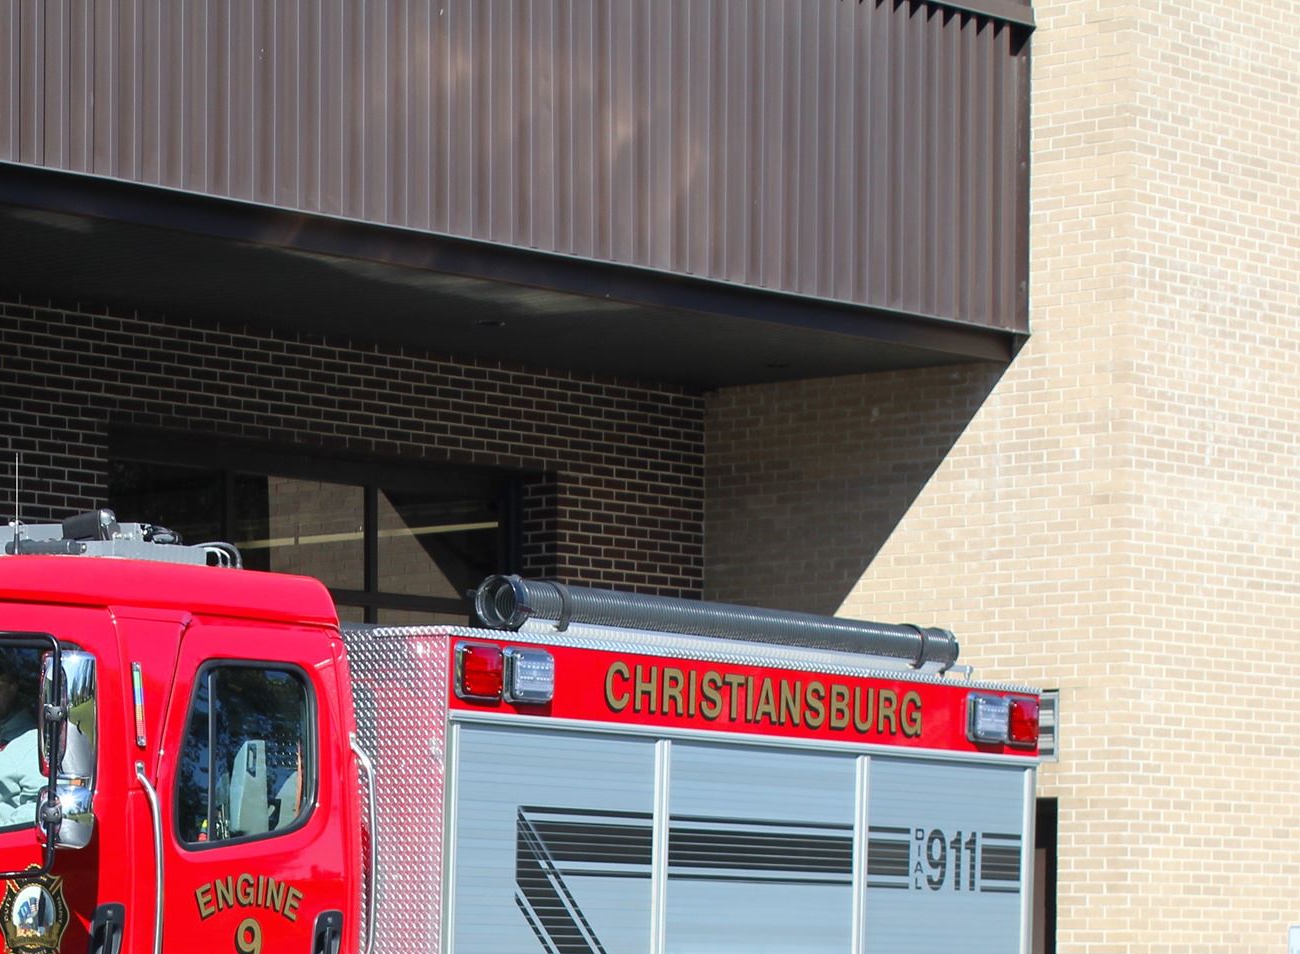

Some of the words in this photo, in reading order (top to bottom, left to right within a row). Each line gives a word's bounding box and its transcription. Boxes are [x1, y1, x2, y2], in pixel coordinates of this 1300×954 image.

[604, 661, 922, 738] CHRISTIANSBURG
[914, 828, 924, 890] DIAL
[927, 828, 977, 891] 911
[195, 873, 304, 922] ENGINE
